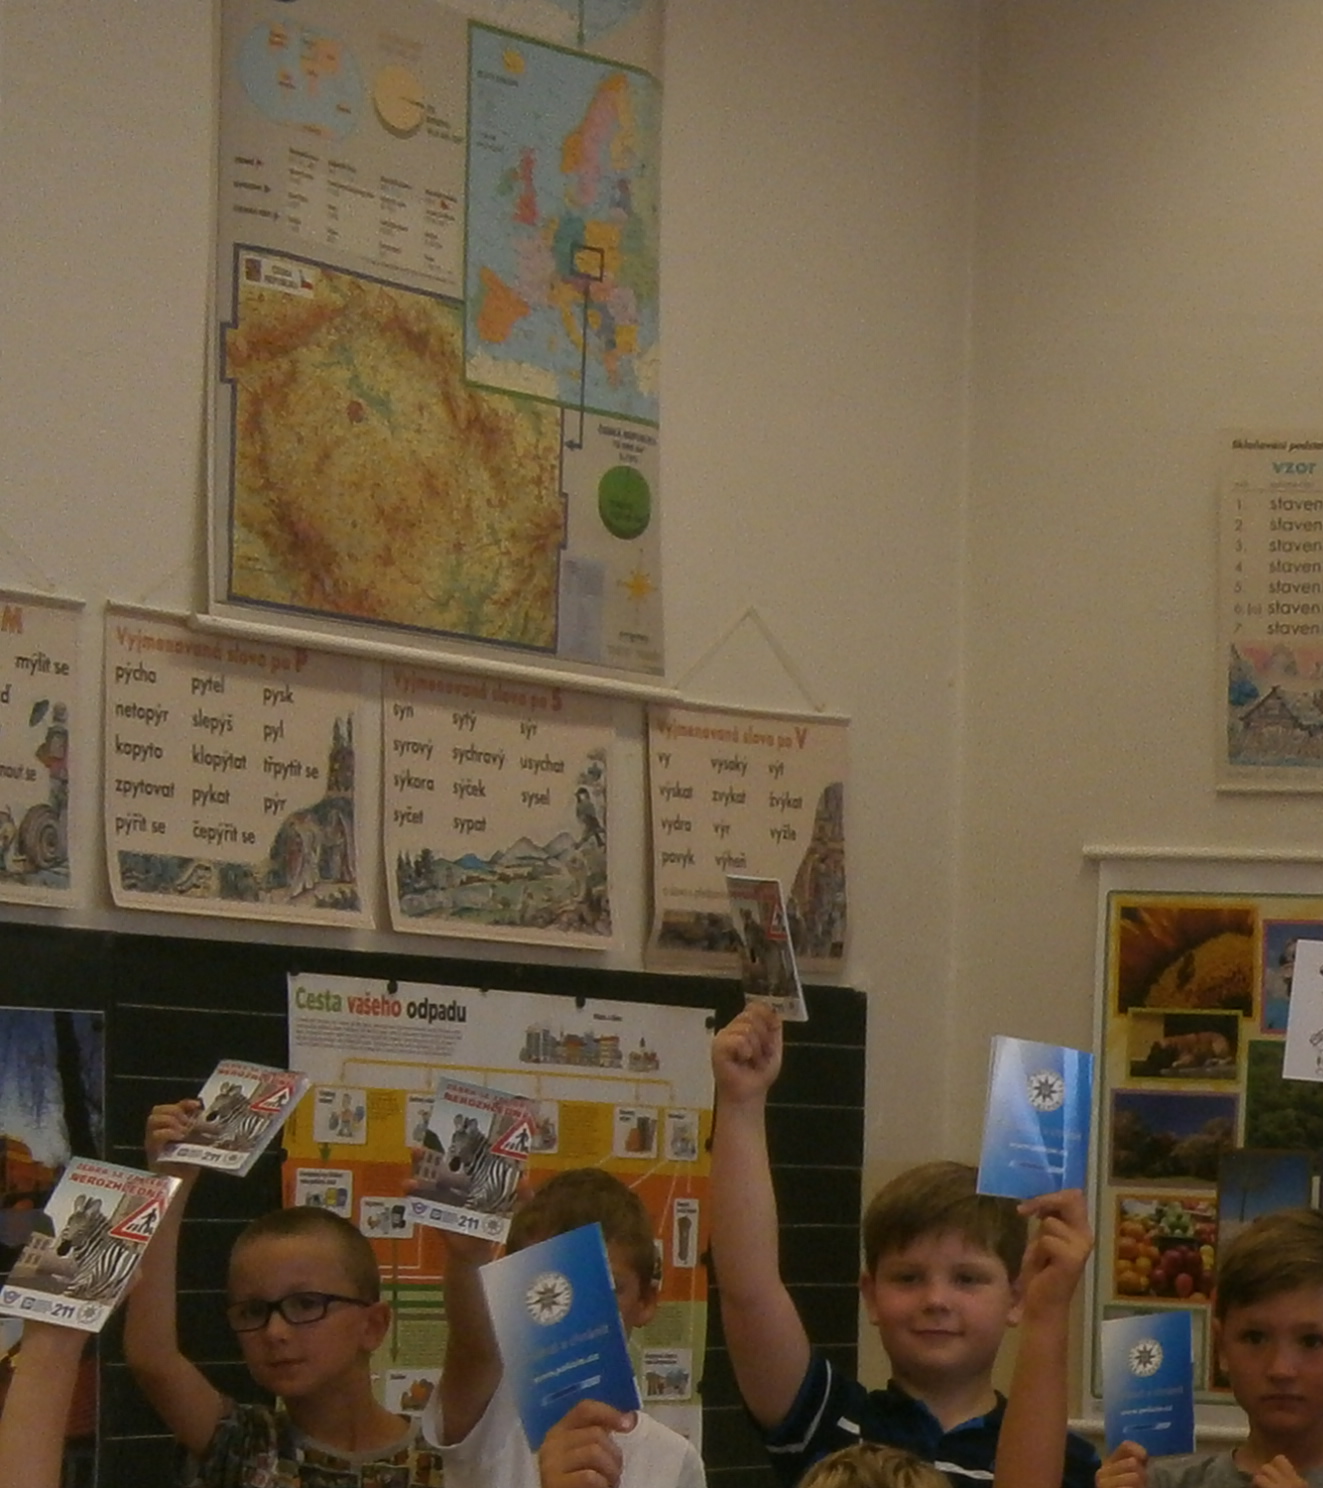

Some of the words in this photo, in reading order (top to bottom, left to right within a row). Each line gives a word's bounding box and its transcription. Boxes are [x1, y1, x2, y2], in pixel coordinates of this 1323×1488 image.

[1272, 461, 1316, 474] vzor
[53, 660, 70, 676] se
[115, 662, 157, 684] pýcha
[191, 675, 225, 696] pytel
[115, 702, 169, 727] netopýr
[192, 708, 233, 735] slepýš
[115, 733, 164, 762] kopyto
[393, 738, 433, 761] syrový
[452, 742, 505, 770] sychravý
[305, 764, 319, 778] se
[393, 768, 435, 792] sýkora
[115, 778, 175, 798] zpytovat
[192, 784, 230, 807] pykat
[151, 819, 166, 834] se
[241, 828, 256, 844] se
[347, 990, 402, 1018] vašeho
[407, 998, 467, 1024] odpadu
[202, 1151, 222, 1162] 211
[458, 1214, 480, 1230] 211
[51, 1303, 75, 1319] 211
